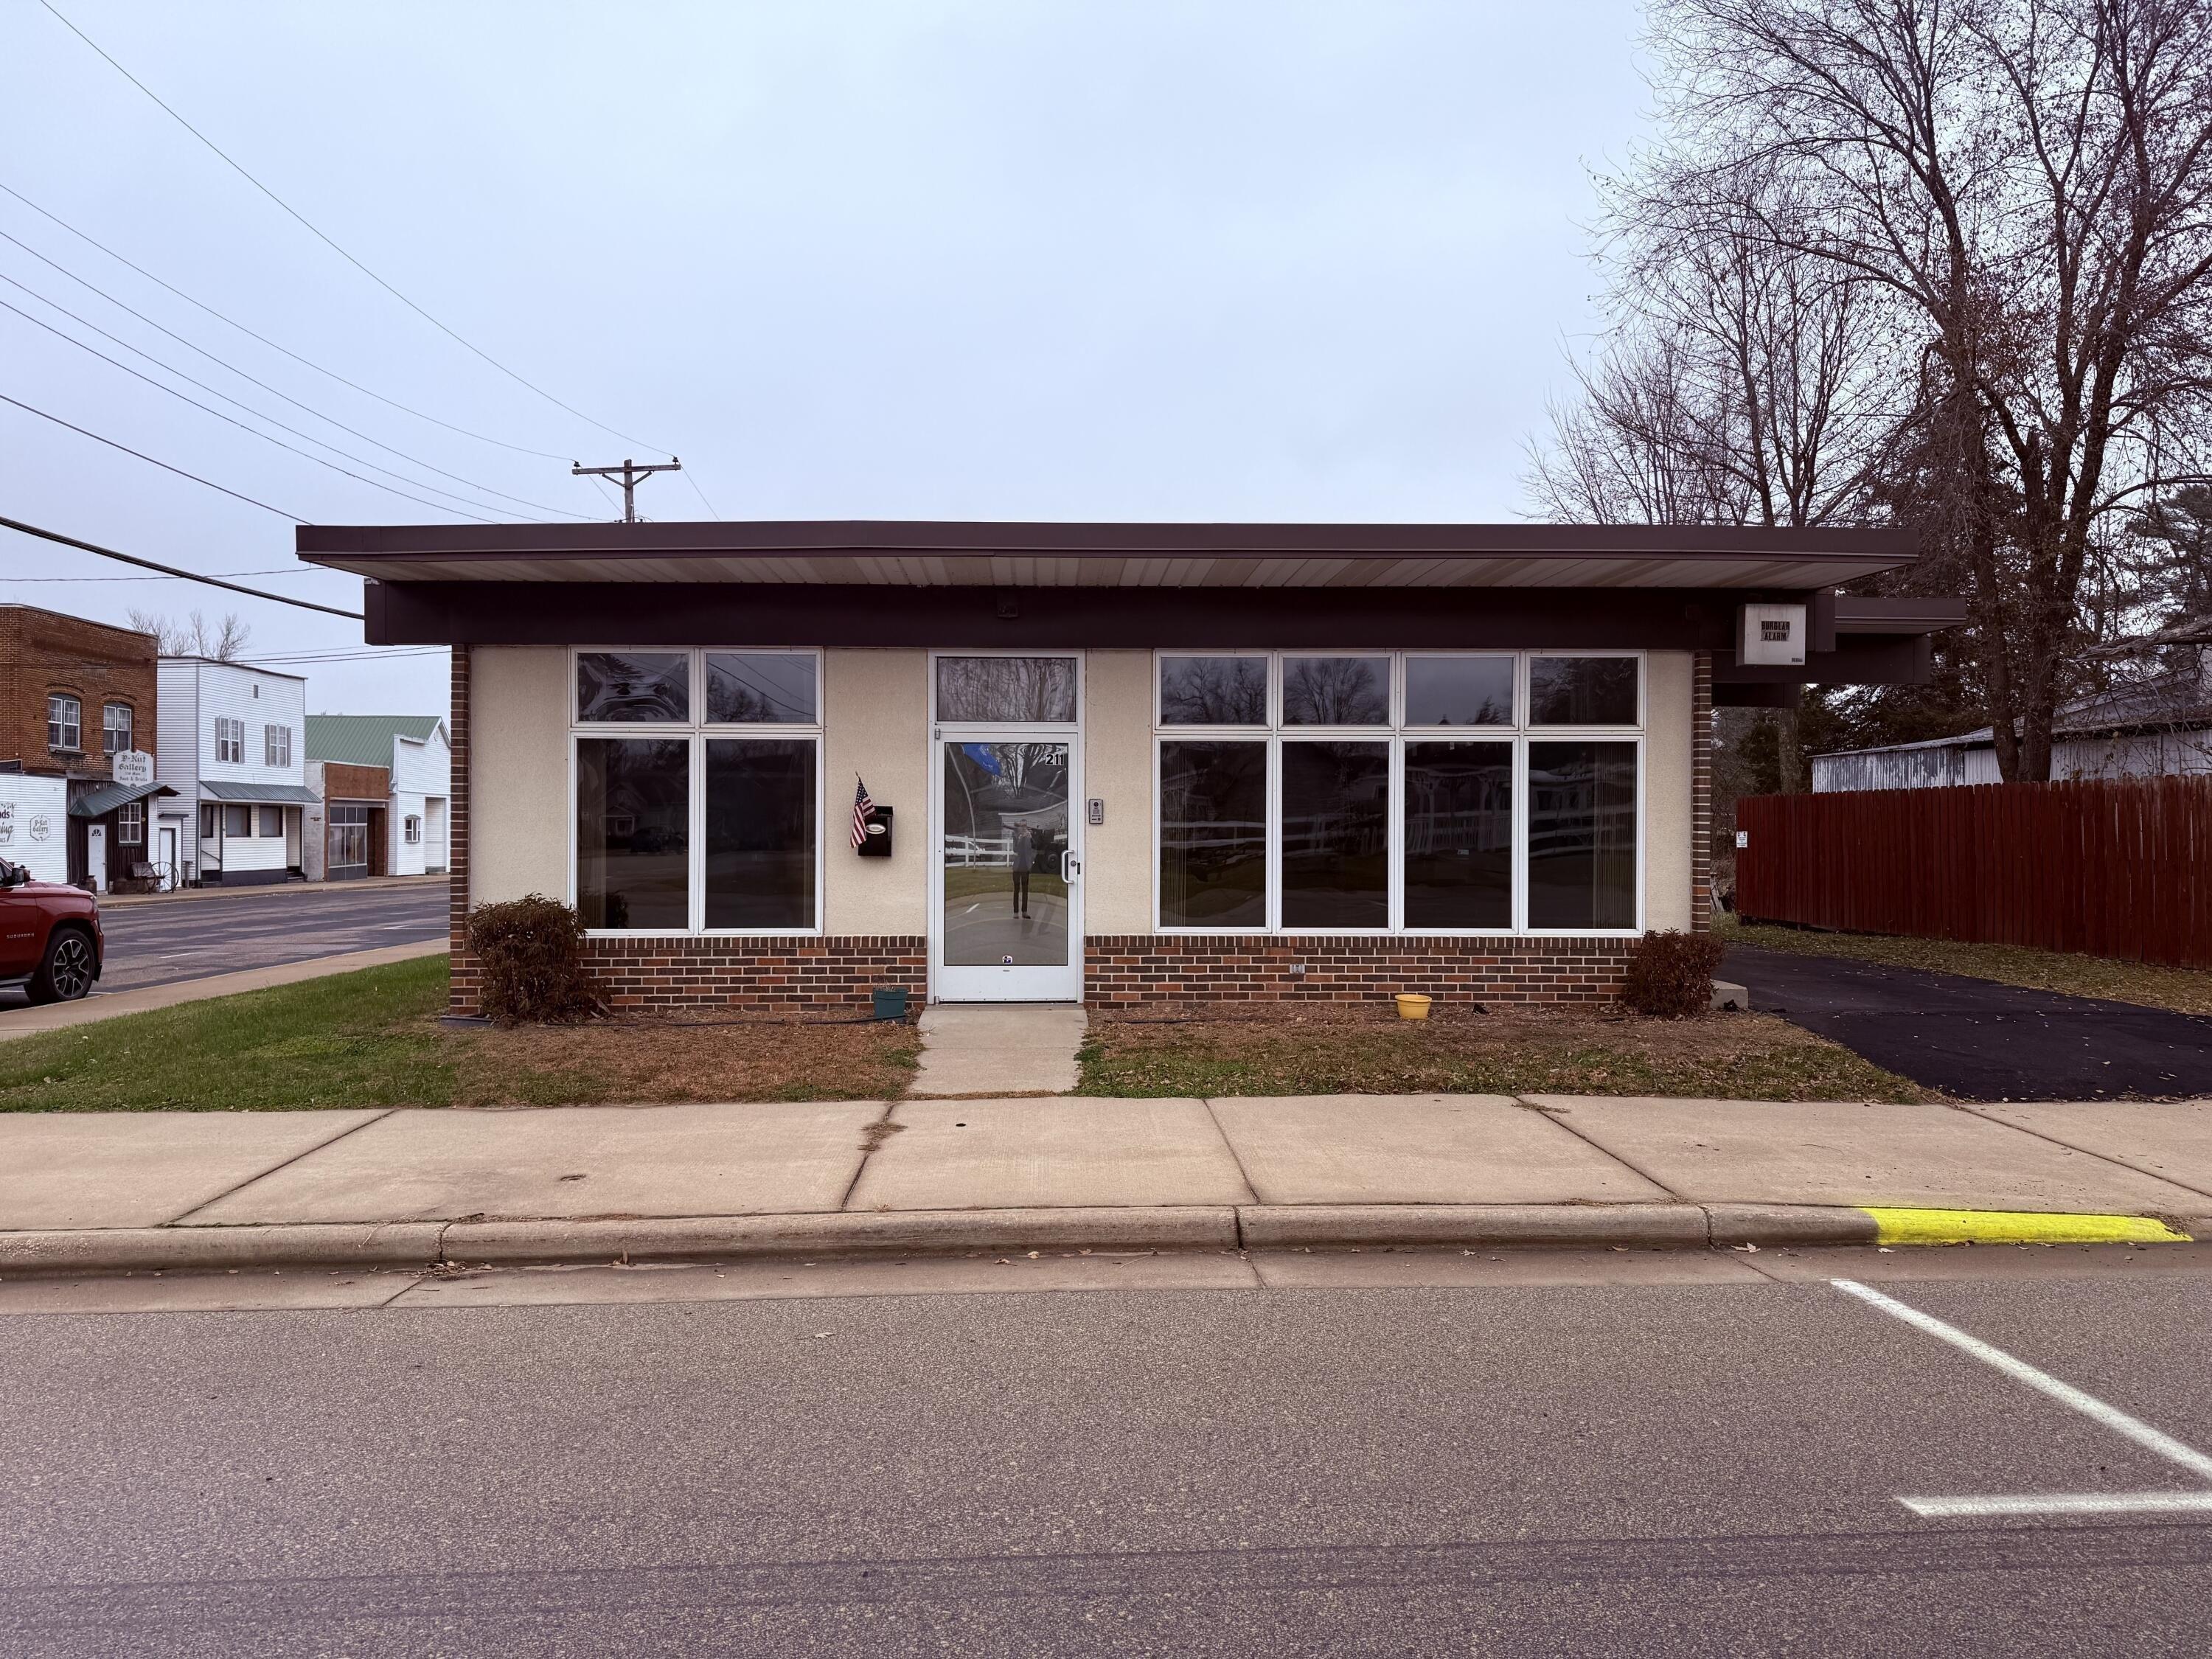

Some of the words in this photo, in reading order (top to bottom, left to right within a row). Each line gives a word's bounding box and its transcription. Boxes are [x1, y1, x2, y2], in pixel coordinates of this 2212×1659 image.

[1761, 621, 1790, 630] BURGLAR
[1764, 632, 1787, 641] ALARM
[121, 754, 145, 762] P-Nut
[1046, 754, 1063, 765] 211
[119, 763, 147, 773] Gallery
